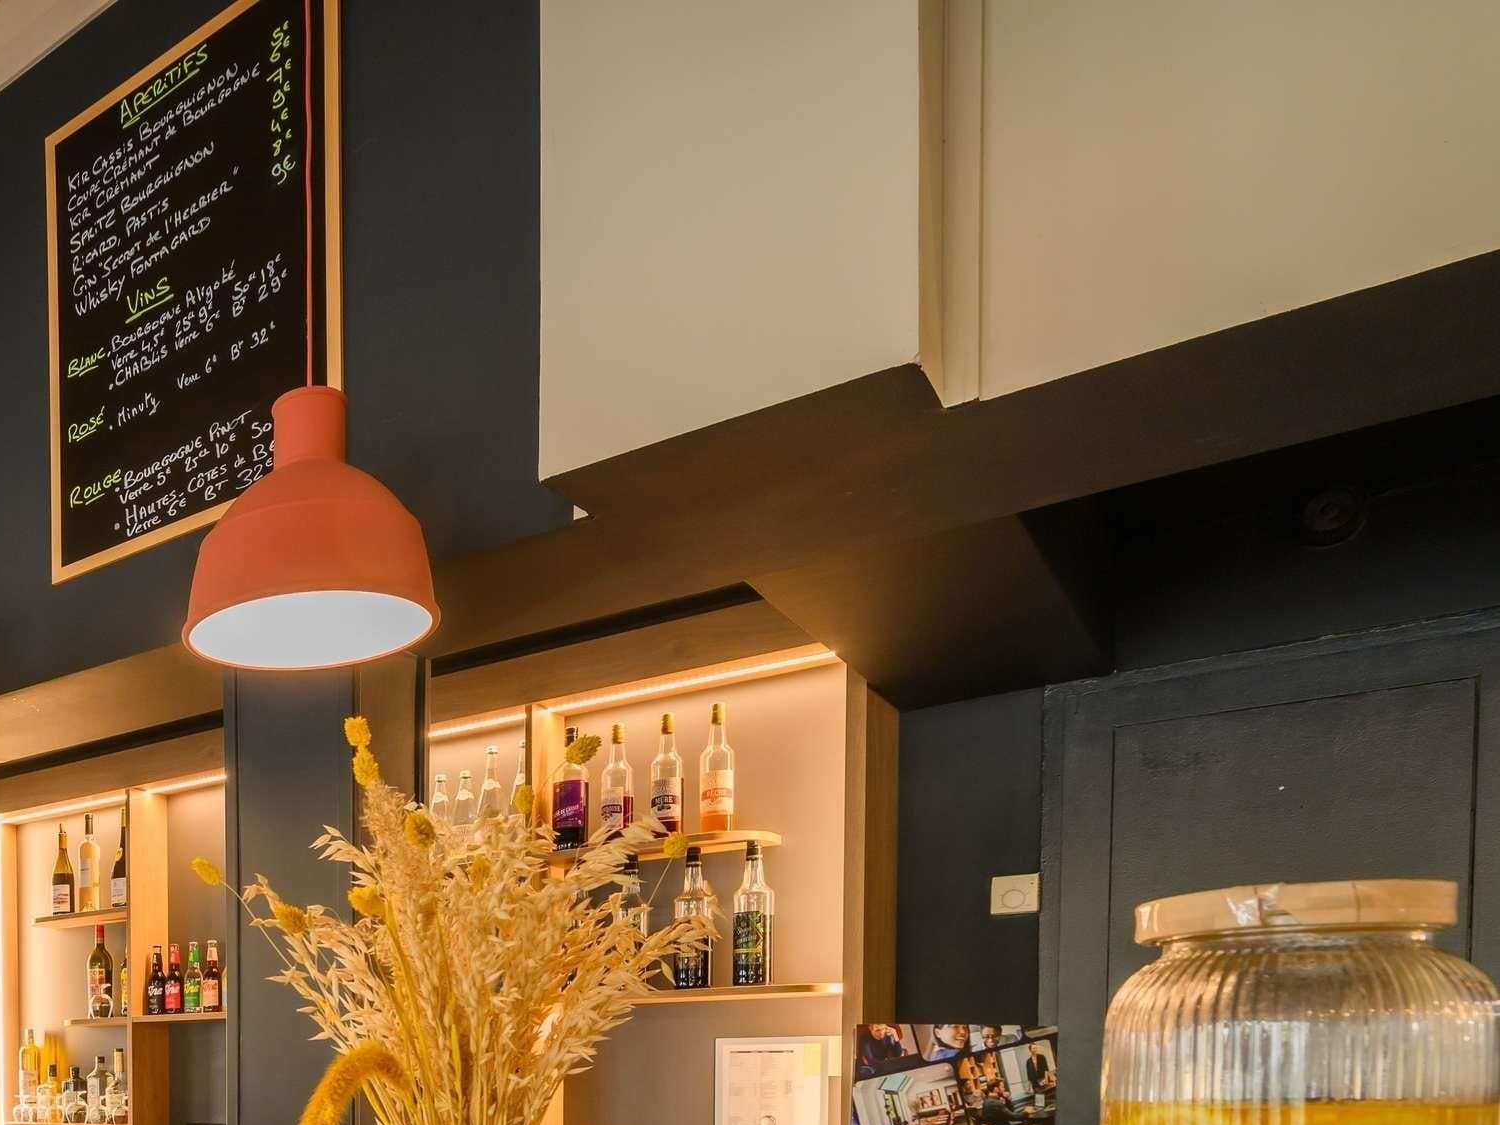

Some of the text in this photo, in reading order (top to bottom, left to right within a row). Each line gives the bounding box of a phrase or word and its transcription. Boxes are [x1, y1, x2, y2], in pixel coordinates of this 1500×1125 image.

[182, 62, 260, 126] BOURGOGNE
[69, 467, 122, 508] ROUGE
[123, 436, 203, 490] BOURGOGNE
